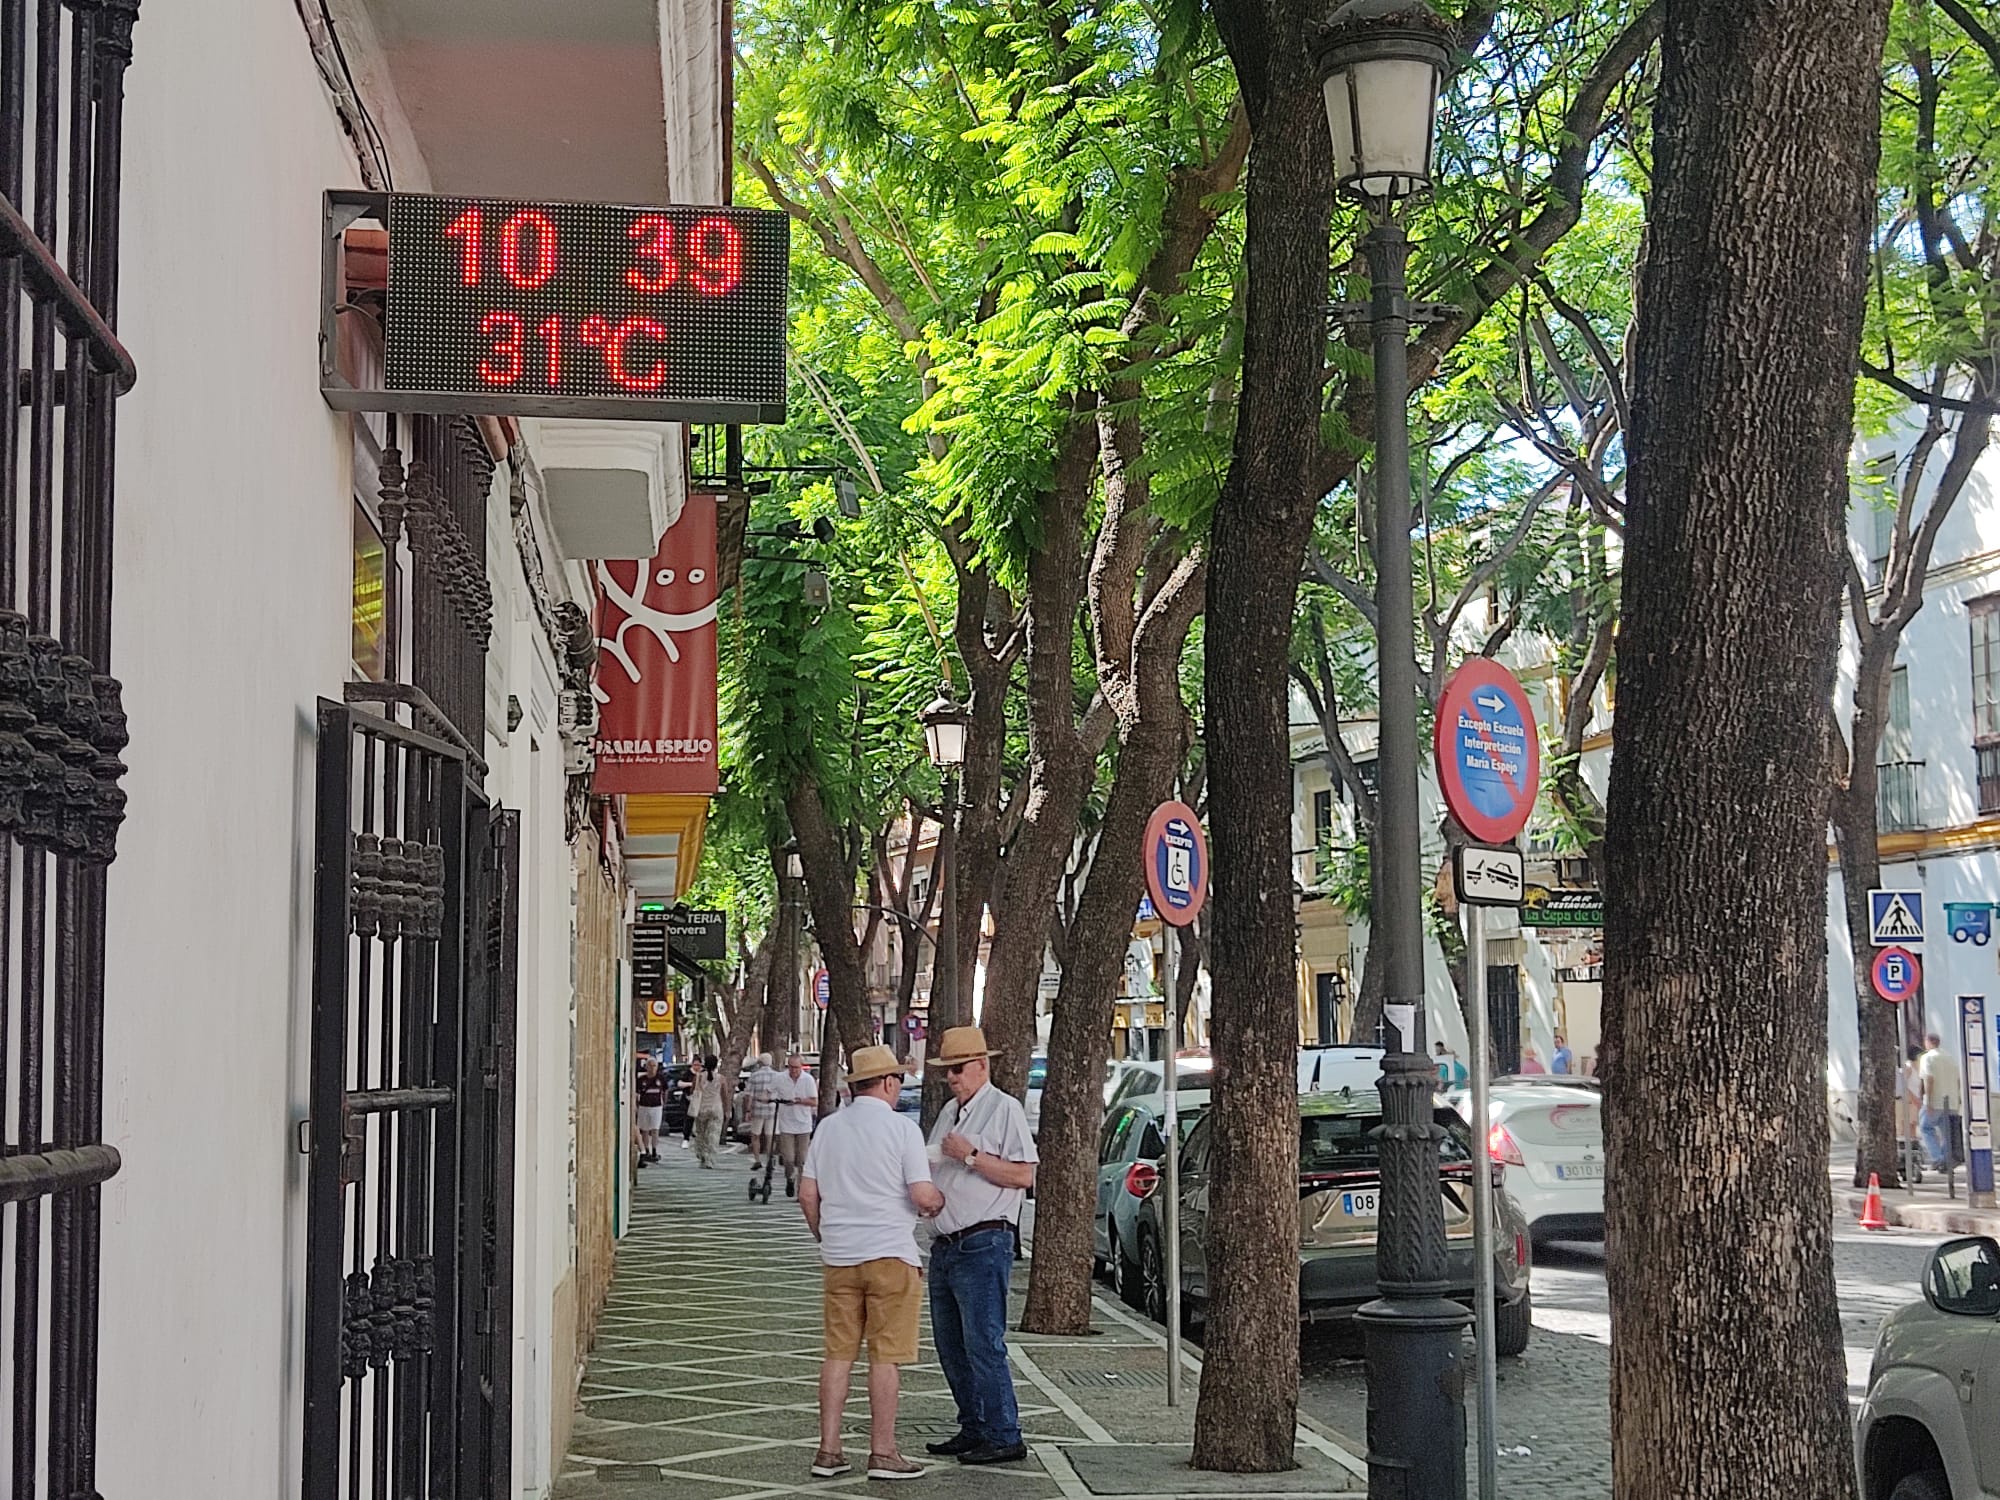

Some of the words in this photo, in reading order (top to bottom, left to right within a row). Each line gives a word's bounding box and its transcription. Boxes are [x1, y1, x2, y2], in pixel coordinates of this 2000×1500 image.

[445, 207, 556, 288] 10
[627, 215, 742, 294] 39
[1458, 716, 1491, 733] Excepto
[1493, 721, 1523, 737] Escuela
[596, 740, 652, 754] MARIA
[656, 739, 712, 753] ESPEJO
[1464, 736, 1521, 755] Interpretación
[1491, 758, 1517, 776] Espejo
[1525, 910, 1538, 920] La
[1542, 910, 1571, 926] Cepa
[1574, 910, 1589, 920] de
[1891, 965, 1900, 978] P
[1565, 1165, 1592, 1177] 3010
